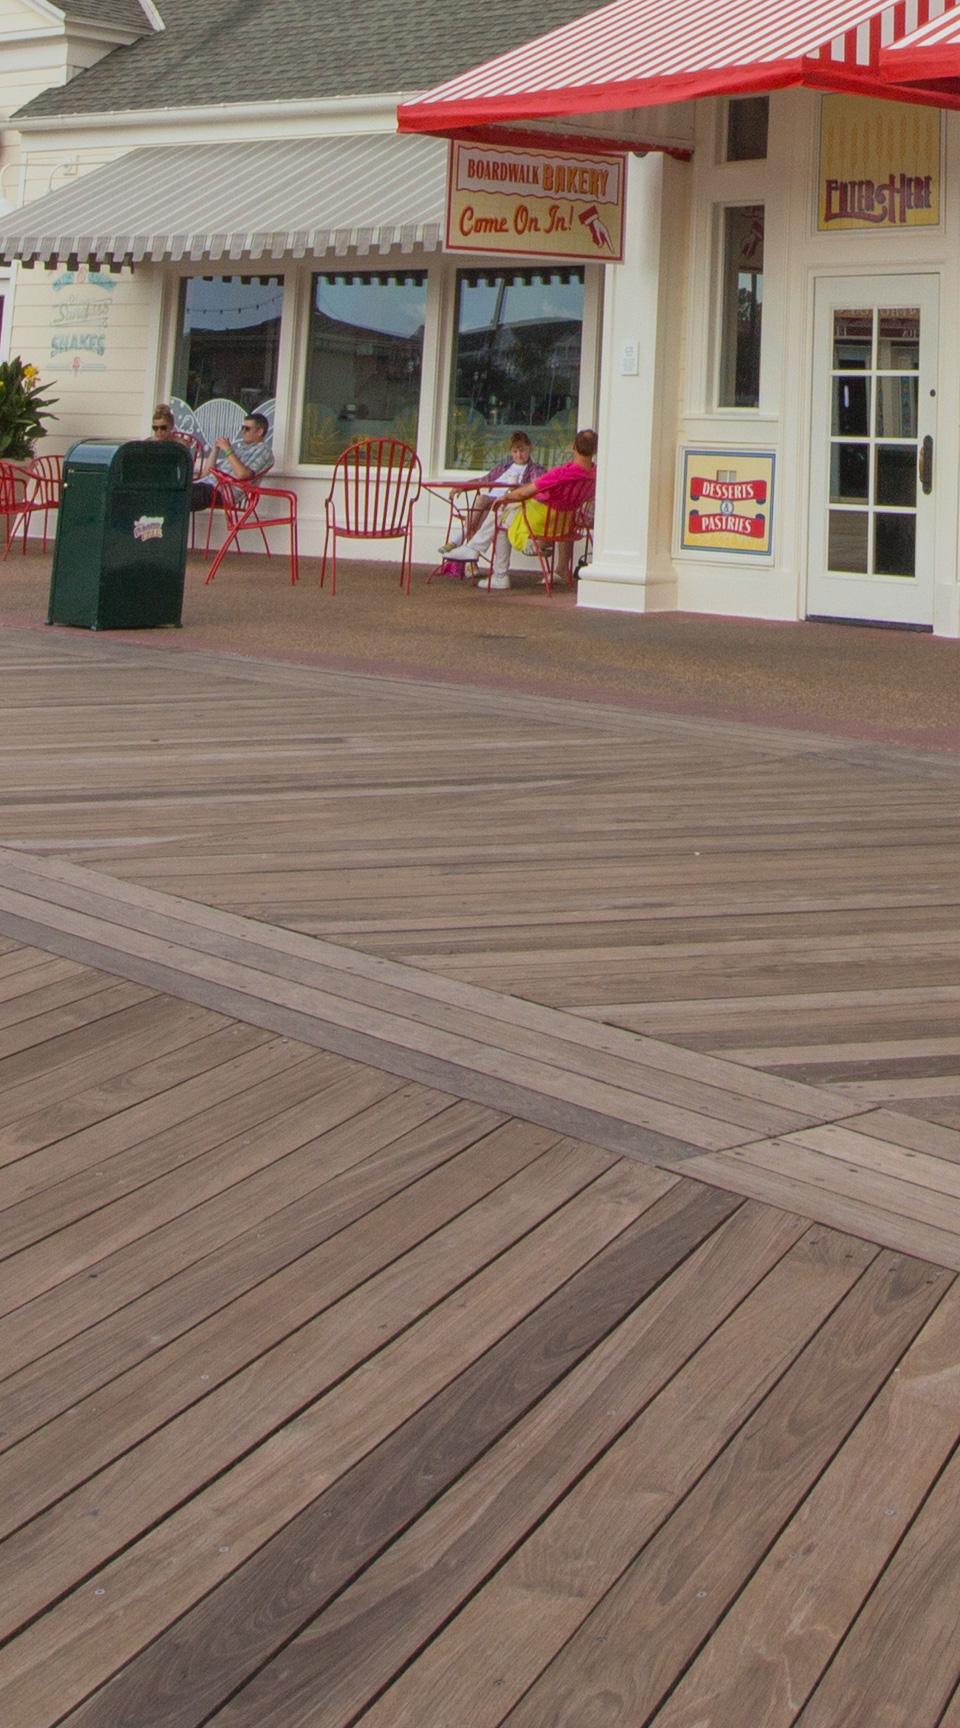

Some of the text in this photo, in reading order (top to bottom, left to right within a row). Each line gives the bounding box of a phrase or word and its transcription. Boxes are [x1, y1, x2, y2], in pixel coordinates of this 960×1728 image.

[467, 158, 609, 199] BOARDWALK BAKERY
[875, 172, 933, 224] HERE
[459, 203, 574, 237] Come On In!
[702, 481, 754, 499] DESSERTS
[701, 516, 752, 534] PASTRIES
